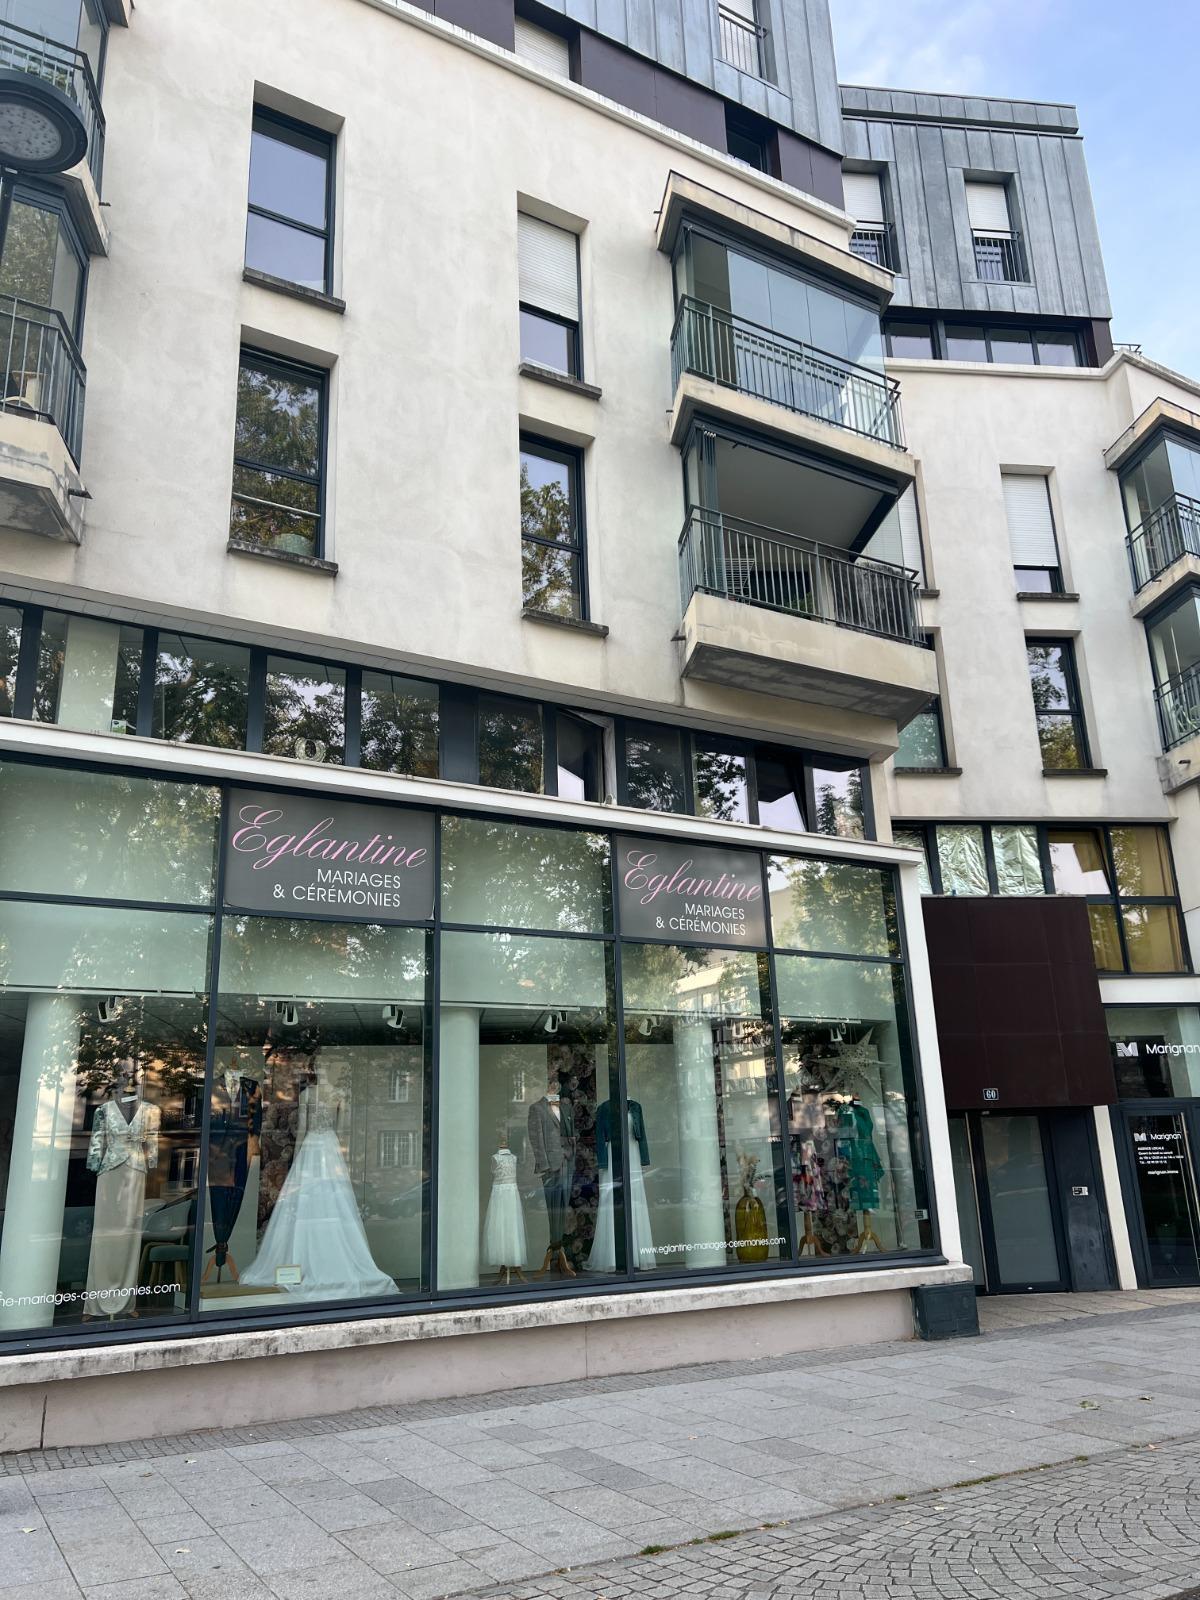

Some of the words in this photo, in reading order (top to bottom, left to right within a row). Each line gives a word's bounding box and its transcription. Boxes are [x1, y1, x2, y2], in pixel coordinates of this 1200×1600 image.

[232, 805, 428, 870] Eglantine
[317, 868, 401, 889] MARIAGES
[624, 850, 762, 905] Eglantine
[273, 883, 285, 899] &
[292, 882, 401, 908] CÉRÉMONIES
[685, 902, 745, 920] MARIAGES
[655, 916, 665, 929] &
[669, 915, 746, 936] CÉRÉMONIES
[1145, 1043, 1200, 1056] Marignan
[986, 1090, 996, 1099] 60
[1150, 1133, 1182, 1141] Marignan
